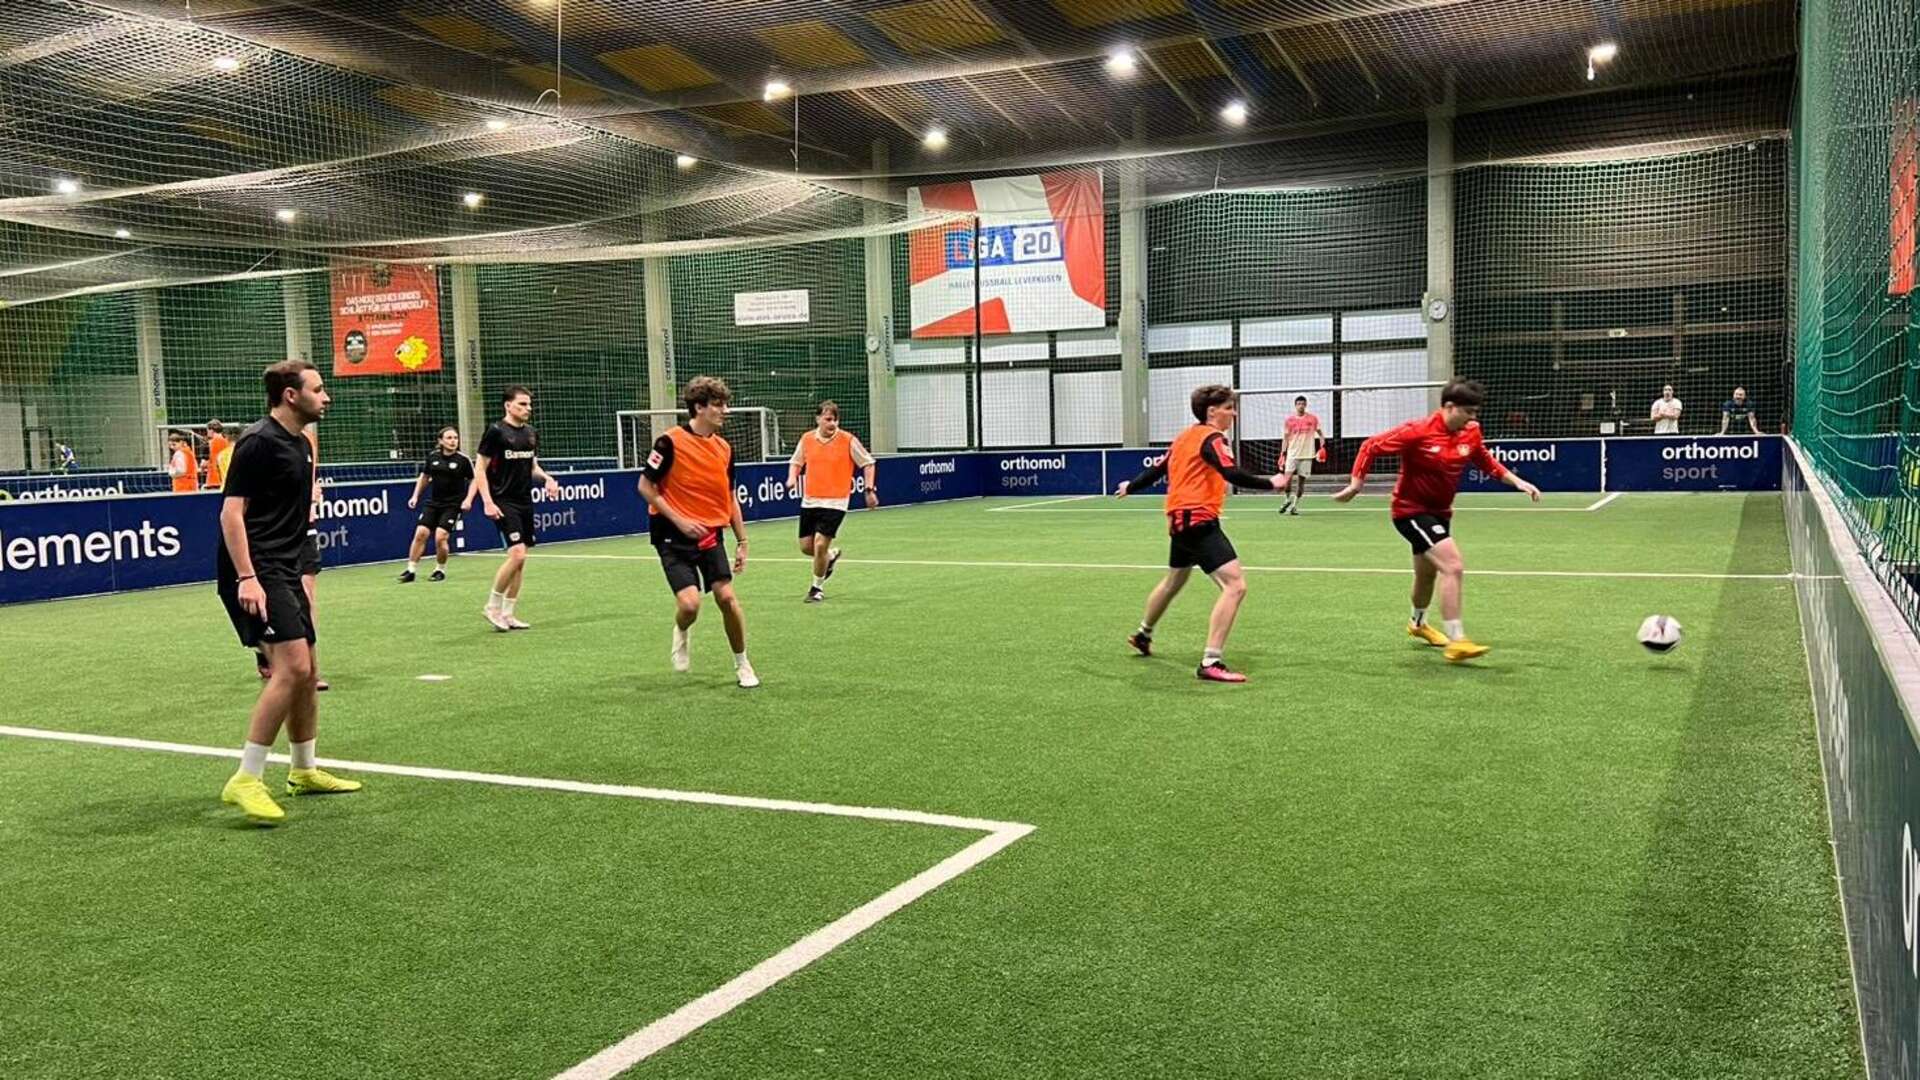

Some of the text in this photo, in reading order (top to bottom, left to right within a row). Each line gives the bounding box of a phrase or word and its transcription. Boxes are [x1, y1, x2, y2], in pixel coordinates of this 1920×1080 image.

[1023, 231, 1052, 255] 20
[1662, 441, 1759, 460] orthomol
[919, 458, 955, 475] orthomol
[1000, 454, 1066, 470] orthomol
[1001, 474, 1039, 488] sport
[1662, 463, 1718, 482] sport
[19, 480, 124, 500] orthomol
[758, 477, 785, 502] die
[920, 478, 942, 494] sport
[533, 507, 576, 532] sport
